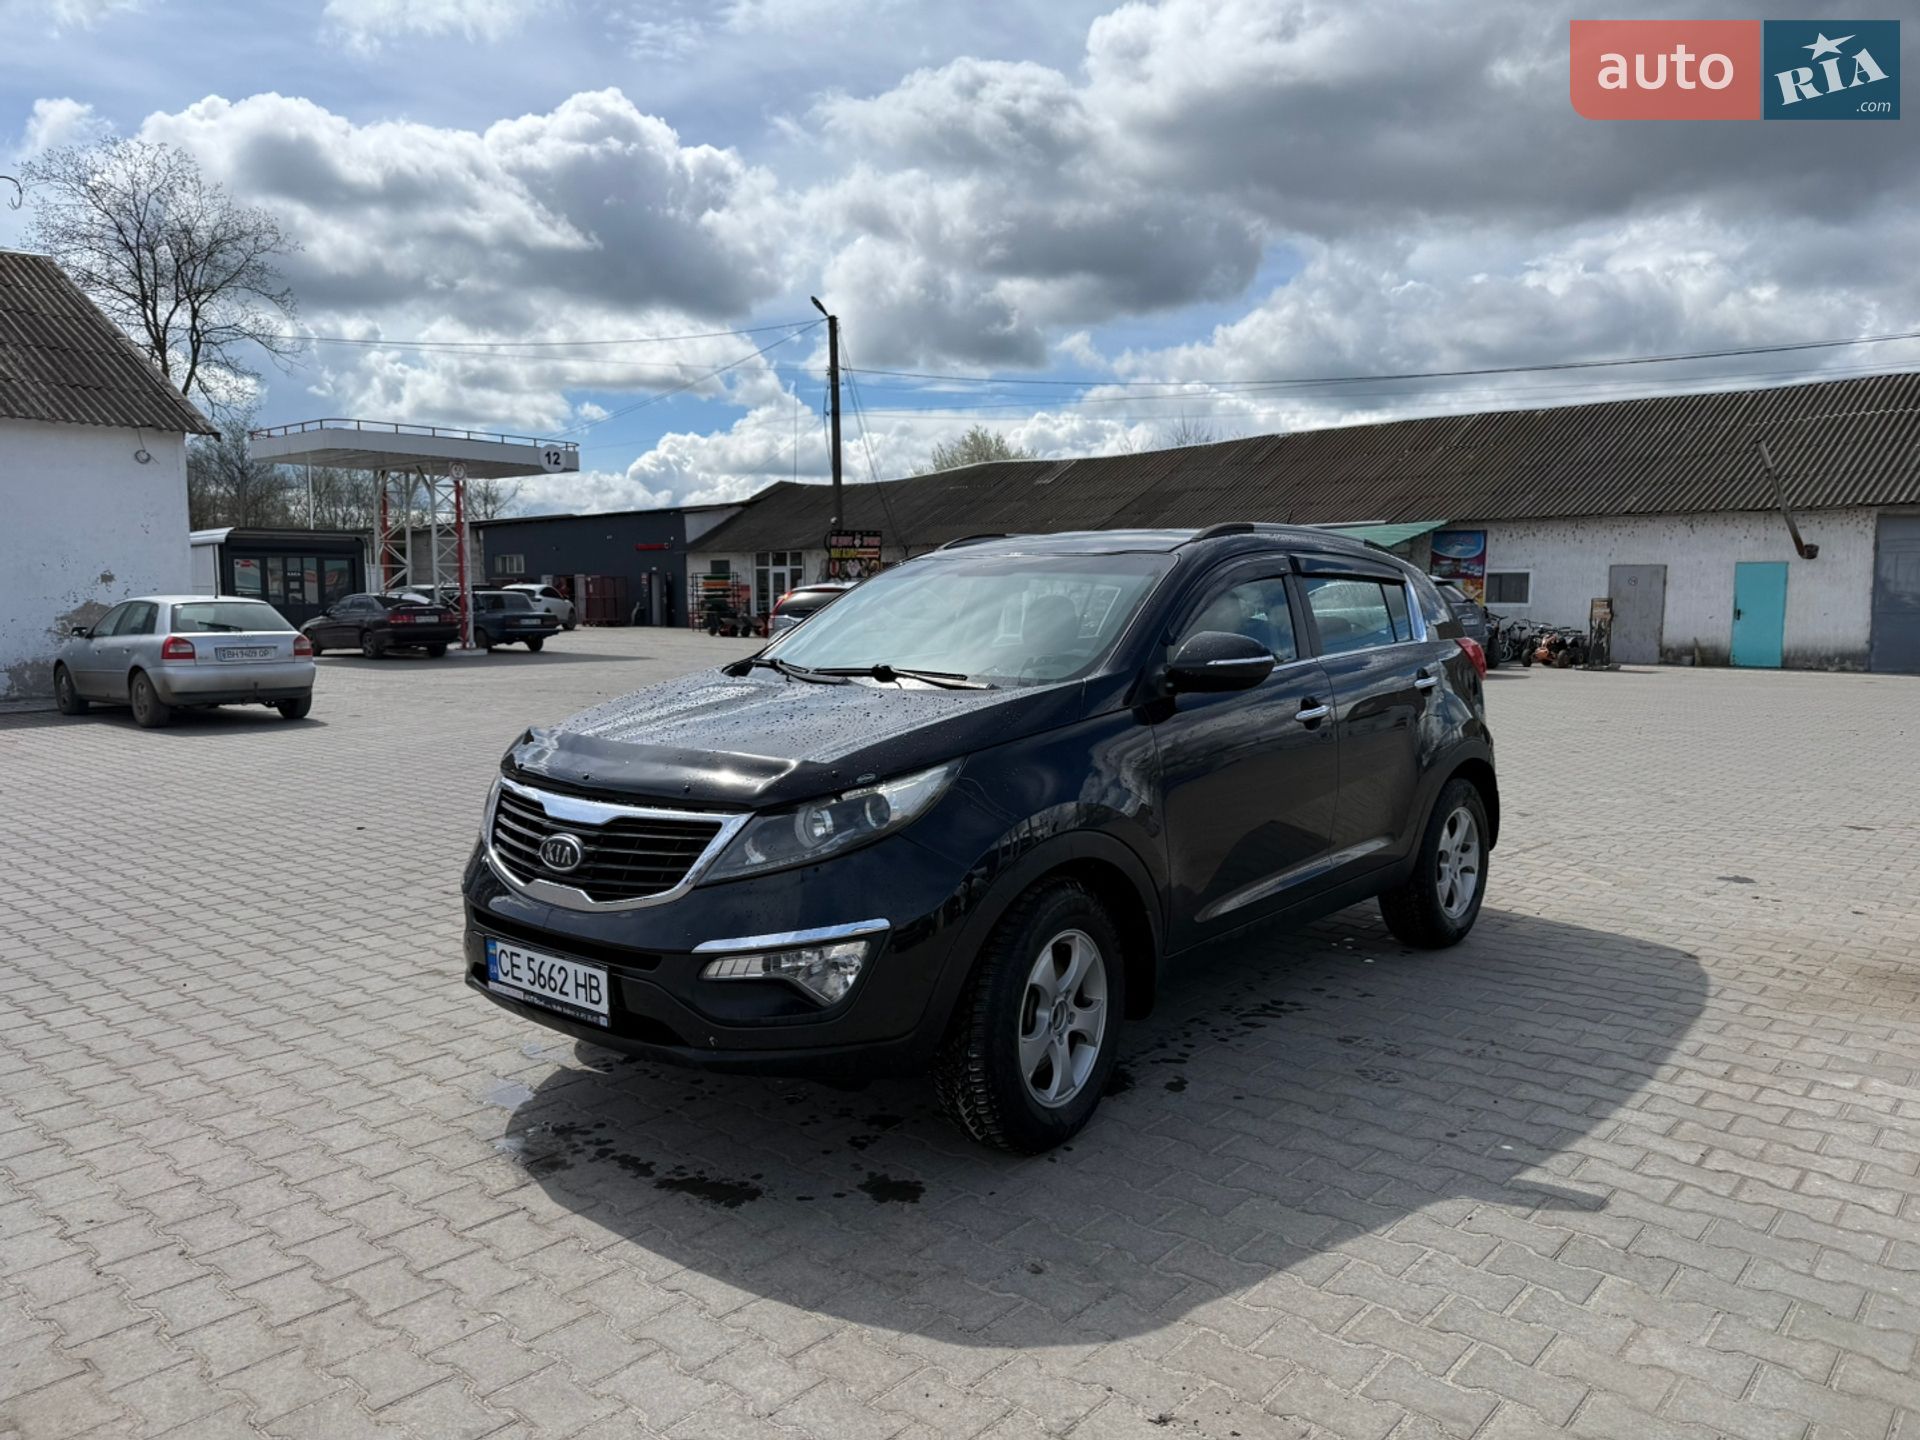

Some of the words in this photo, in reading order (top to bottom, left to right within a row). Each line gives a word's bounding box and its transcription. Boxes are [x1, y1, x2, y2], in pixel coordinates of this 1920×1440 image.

[545, 451, 561, 465] 12
[545, 842, 572, 865] KIA
[498, 948, 522, 982] CE
[527, 956, 570, 997] 5662
[574, 969, 602, 1005] HB
